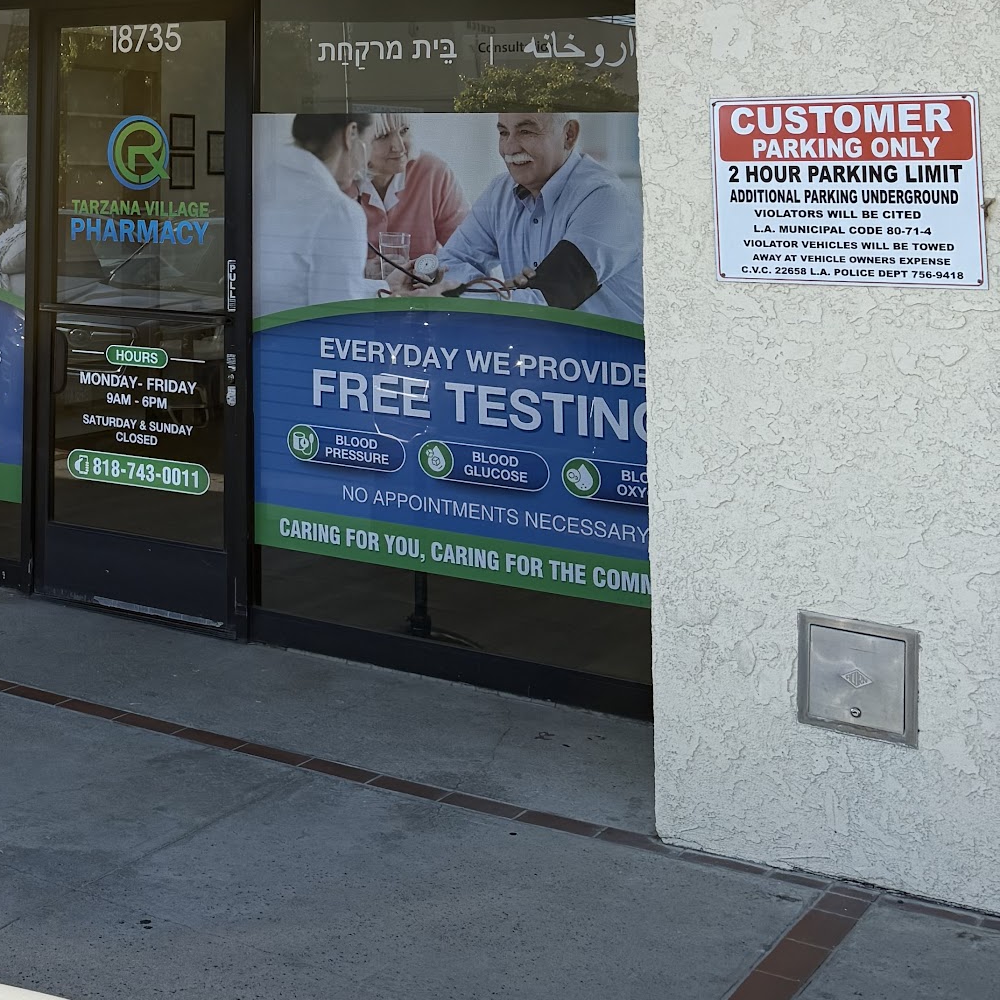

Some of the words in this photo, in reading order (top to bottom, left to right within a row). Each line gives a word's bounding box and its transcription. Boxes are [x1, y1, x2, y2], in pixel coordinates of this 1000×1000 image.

[110, 23, 181, 53] 18735
[731, 103, 952, 135] CUSTOMER
[754, 138, 863, 158] PARKING
[871, 137, 940, 157] ONLY
[729, 166, 739, 182] 2
[746, 166, 801, 182] HOUR
[808, 166, 898, 182] PARKING
[906, 165, 962, 182] LIMIT
[730, 190, 800, 203] ADDITIONAL
[805, 190, 858, 203] PARKING
[862, 190, 959, 204] UNDERGROUND
[72, 199, 140, 216] TARZANA
[145, 201, 210, 218] VILLAGE
[755, 210, 823, 218] VIOLATORS
[828, 210, 857, 218] WILL
[862, 210, 878, 218] BE
[883, 210, 921, 219] CITED
[70, 218, 209, 245] PHARMACY
[754, 225, 775, 233] L.A.
[779, 226, 845, 234] MUNICIPAL
[849, 227, 882, 235] CODE
[886, 227, 932, 236] 80-71-4
[744, 240, 798, 249] VIOLATOR
[802, 241, 858, 250] VEHICLES
[862, 242, 889, 250] WILL
[893, 242, 908, 250] BE
[912, 243, 954, 251] TOWED
[753, 254, 782, 262] AWAY
[800, 255, 846, 263] VEHICLE
[849, 256, 896, 264] OWNERS
[900, 258, 950, 266] EXPENSE
[742, 266, 771, 274] C.V.C.
[775, 267, 806, 275] 22658
[810, 268, 830, 276] L.A.
[834, 268, 875, 277] POLICE
[879, 270, 908, 278] DEPT
[912, 271, 964, 279] 756-9418
[116, 350, 158, 364] HOURS
[320, 337, 459, 370] EVERYDAY
[466, 350, 510, 375] WE
[520, 355, 646, 387] PROVIDE
[147, 378, 197, 395] FRIDAY
[313, 369, 430, 418] FREE
[107, 393, 131, 406] 9AM
[142, 396, 168, 409] 6PM
[83, 414, 137, 430] SATURDAY
[139, 420, 146, 430] &
[149, 422, 193, 436] SUNDAY
[116, 432, 158, 445] CLOSED
[335, 435, 378, 450] BLOOD
[325, 447, 389, 465] PRESSURE
[472, 452, 519, 468] BLOOD
[92, 458, 199, 488] 818-743-0011
[464, 464, 528, 483] GLUCOSE
[616, 484, 648, 498] OXY
[342, 486, 368, 503] NO
[372, 490, 519, 525] APPOINTMENTS
[525, 513, 649, 544] NECESSARY
[279, 518, 341, 545] CARING
[346, 528, 379, 552] FOR
[384, 534, 426, 563] YOU,
[431, 542, 500, 572] CARING
[505, 553, 543, 578] FOR
[549, 560, 586, 584] THE
